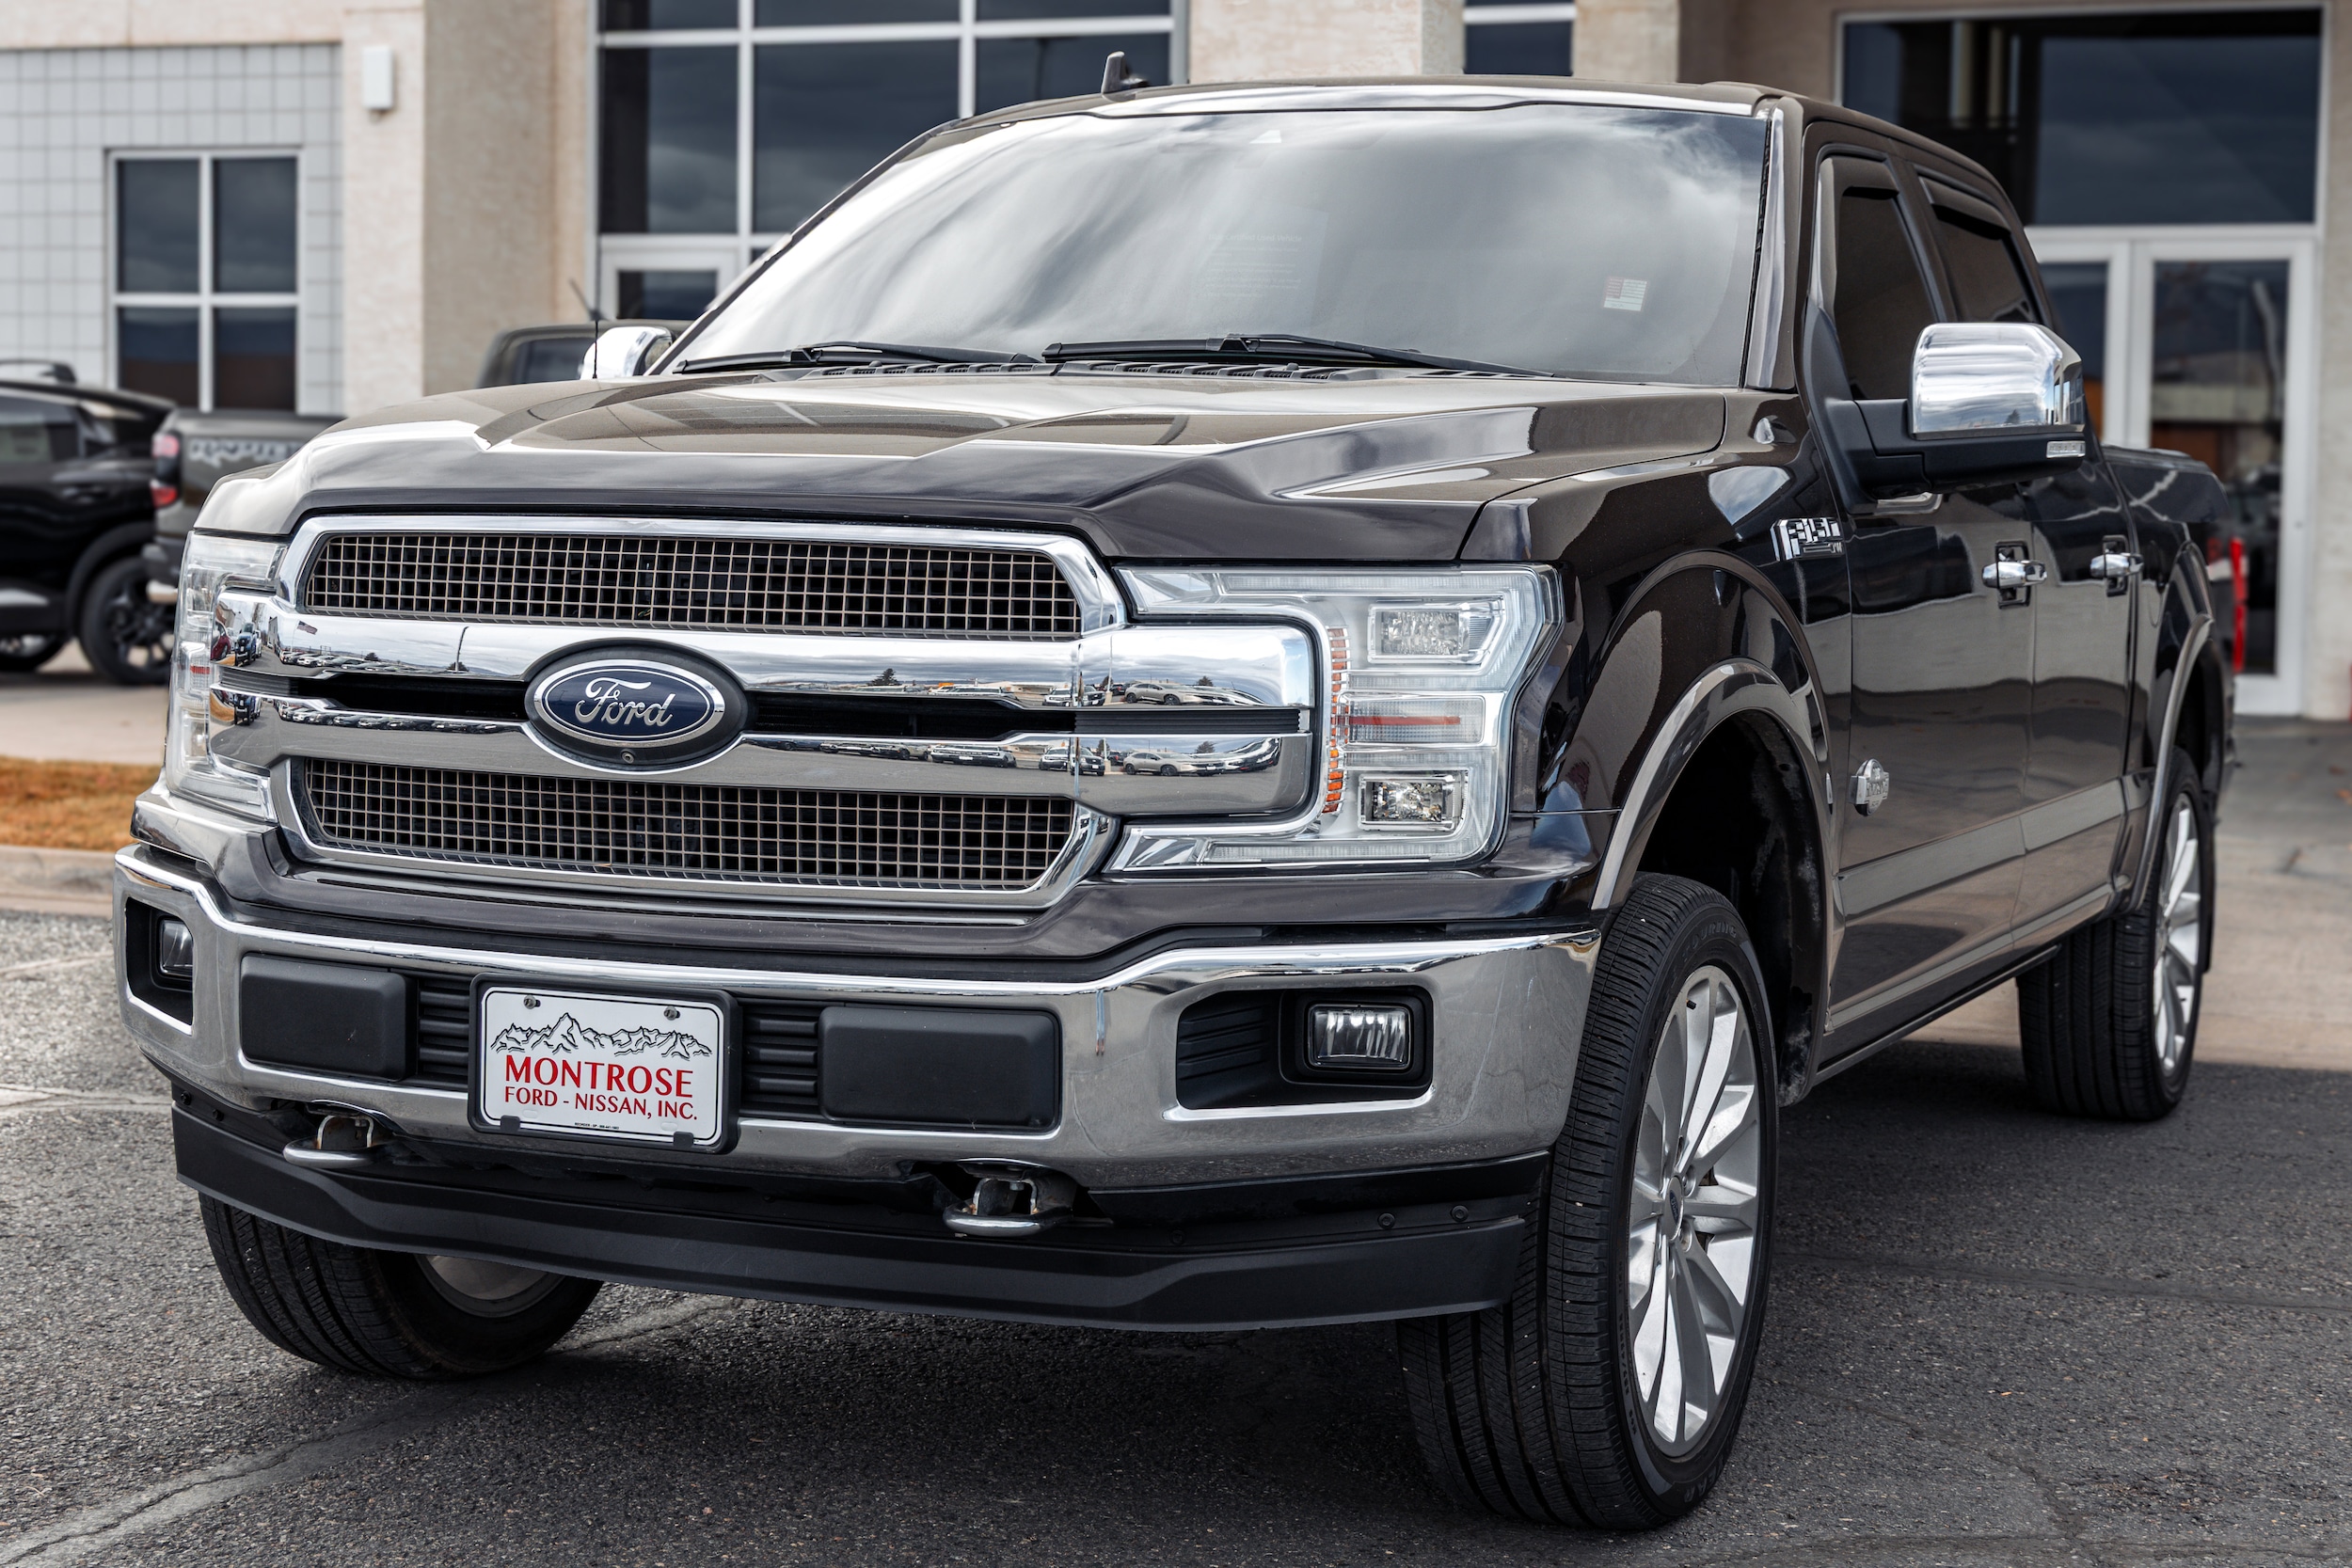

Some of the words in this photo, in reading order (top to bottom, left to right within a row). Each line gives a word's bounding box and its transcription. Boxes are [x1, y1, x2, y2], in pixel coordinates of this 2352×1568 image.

[575, 677, 676, 727] Ford
[505, 1054, 694, 1098] MONTROSE
[504, 1085, 558, 1107] FORD
[575, 1093, 652, 1119] NISSAN,
[658, 1100, 697, 1120] INC.
